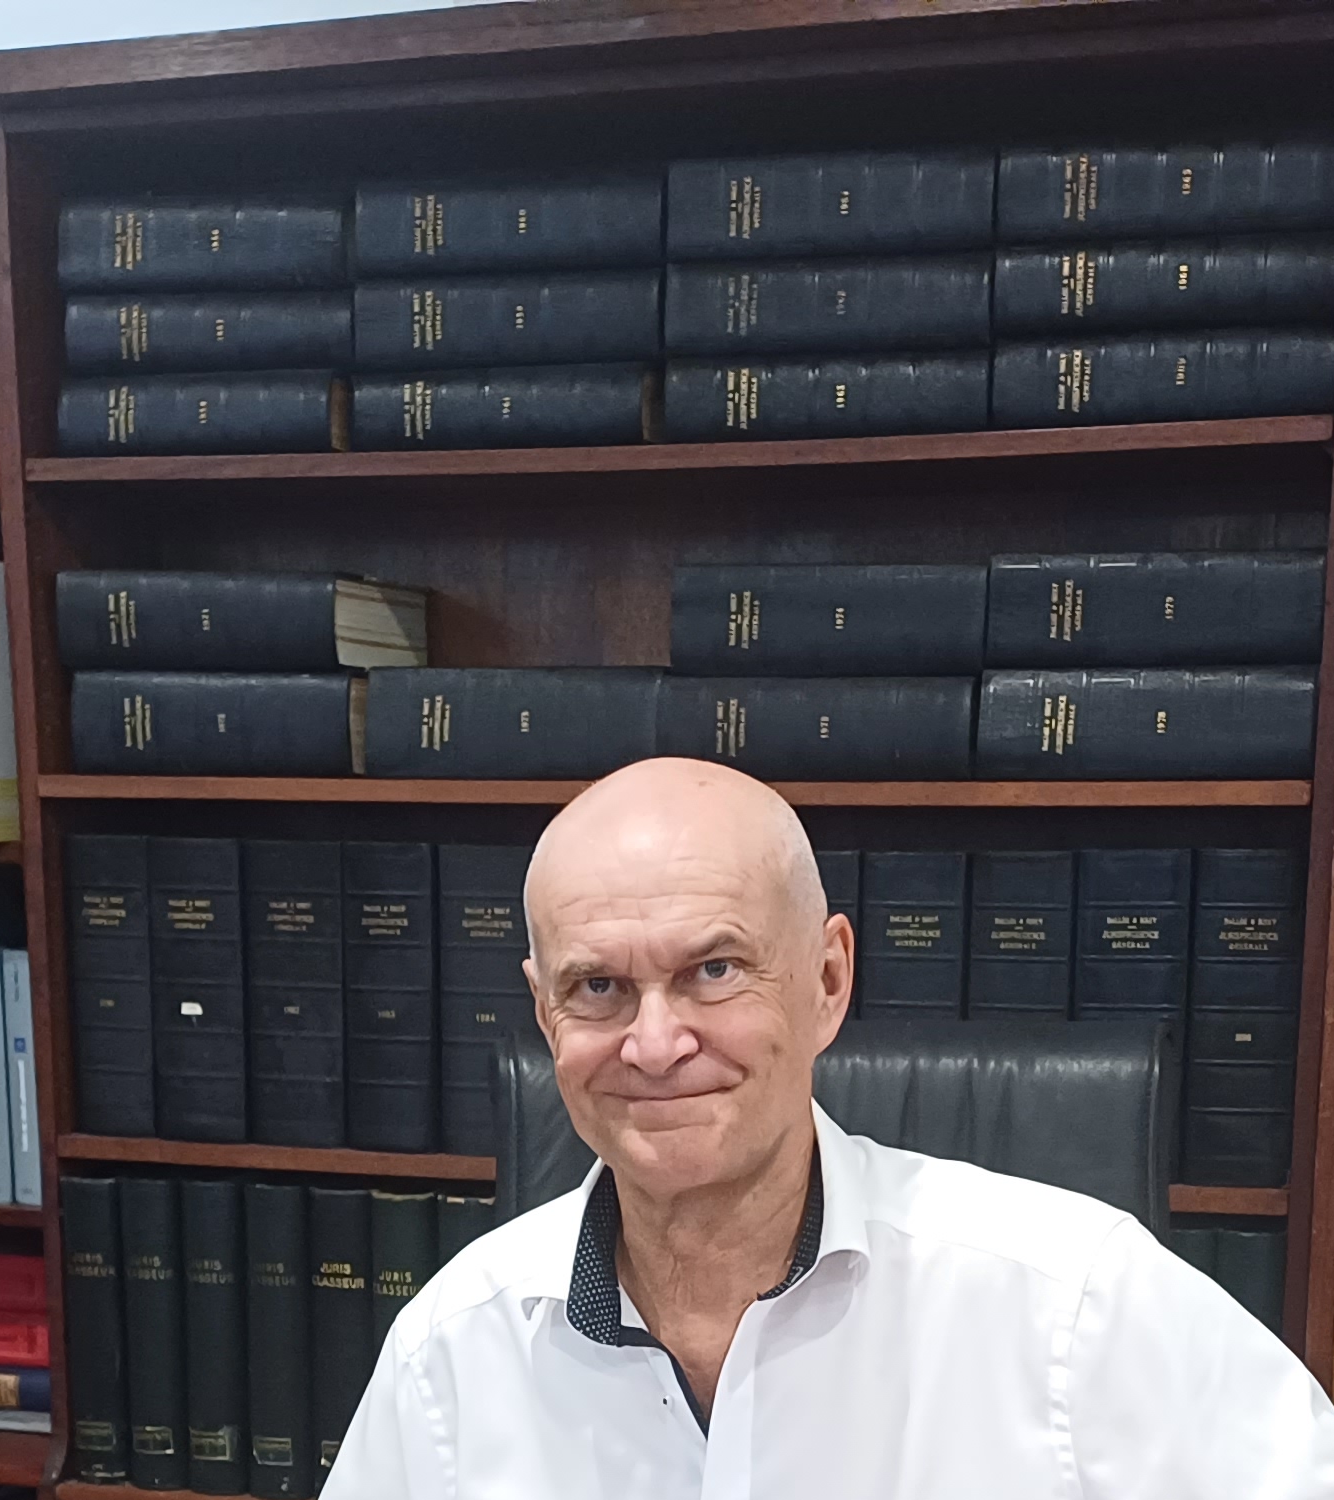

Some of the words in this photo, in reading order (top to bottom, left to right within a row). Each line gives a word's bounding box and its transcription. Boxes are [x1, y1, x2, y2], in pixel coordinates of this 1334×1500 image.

[320, 1262, 351, 1275] JURIS
[312, 1275, 364, 1289] CLASSEUR
[379, 1270, 412, 1283] JURIS
